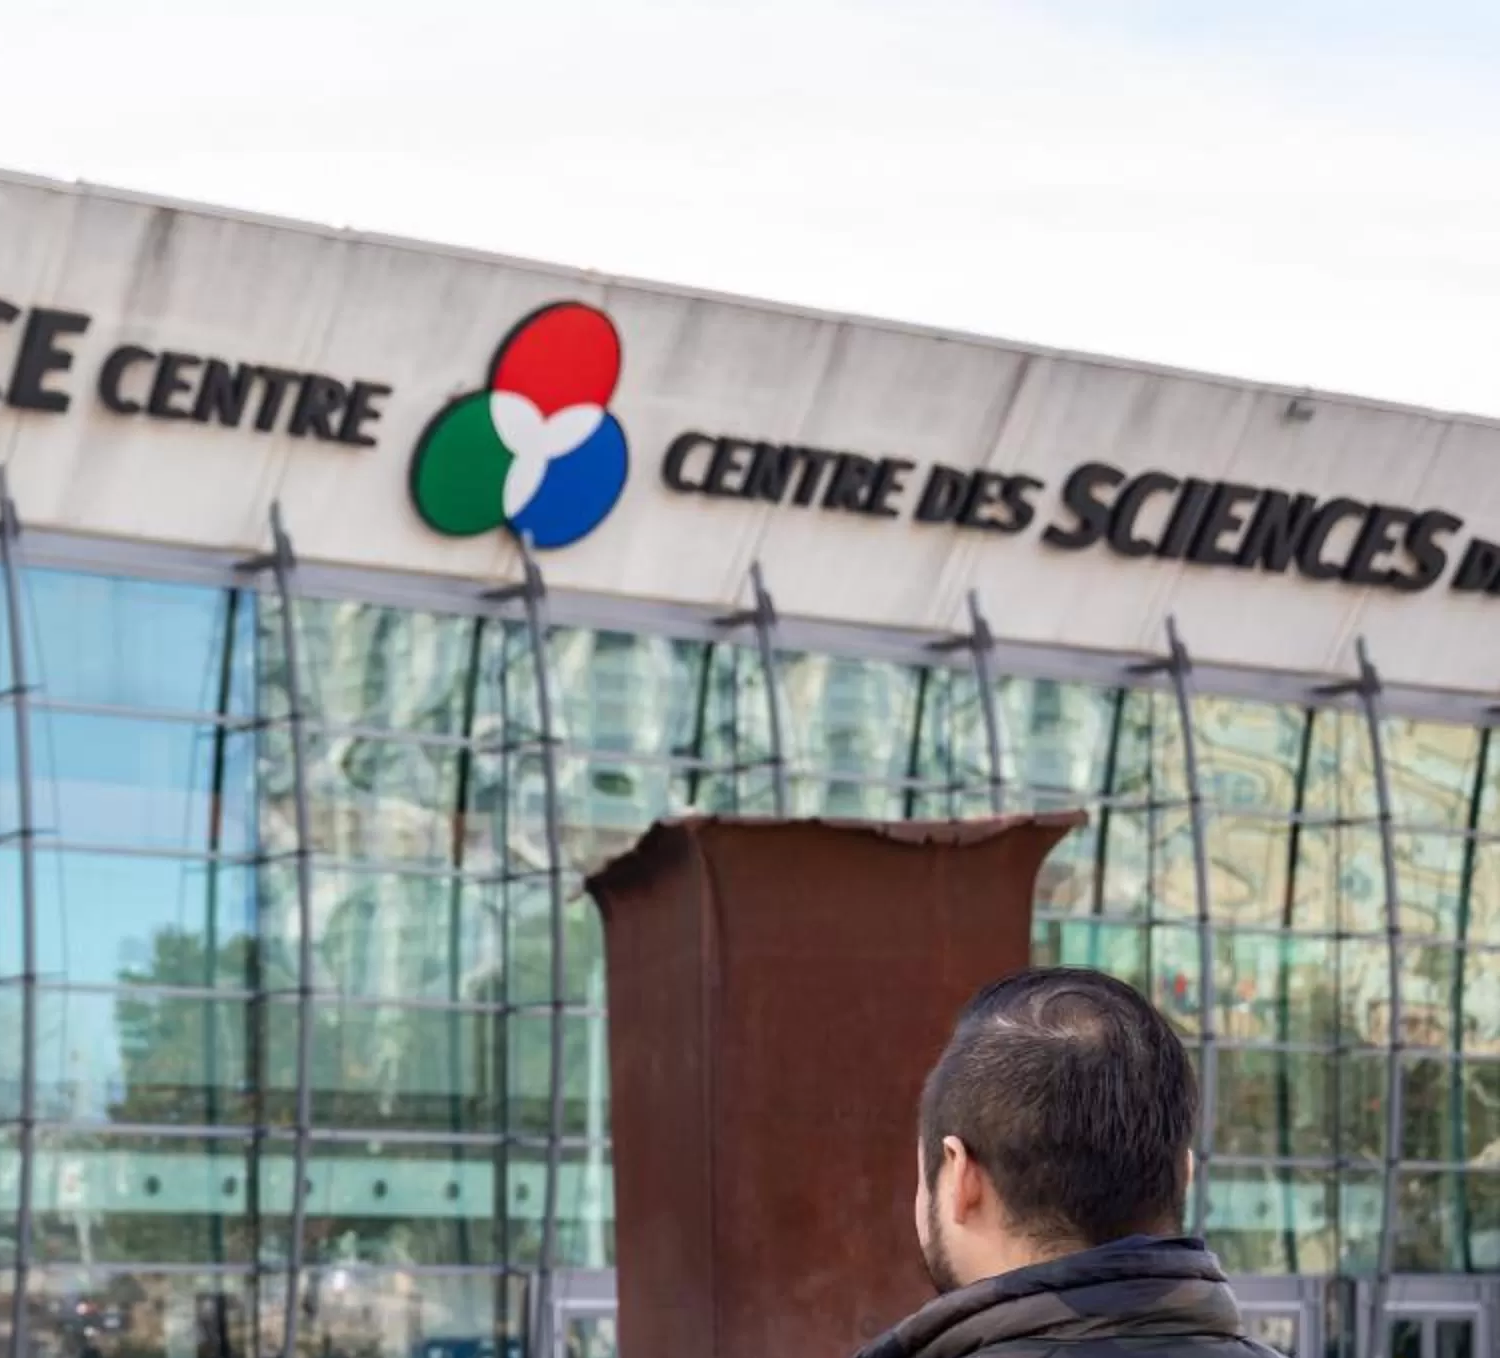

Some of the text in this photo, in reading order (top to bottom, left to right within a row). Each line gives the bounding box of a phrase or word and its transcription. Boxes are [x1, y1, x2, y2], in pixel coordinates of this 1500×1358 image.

[95, 344, 393, 449] CENTRE
[660, 430, 917, 520] CENTRE
[913, 462, 1046, 536] DES
[1040, 461, 1465, 595] SCIENCES
